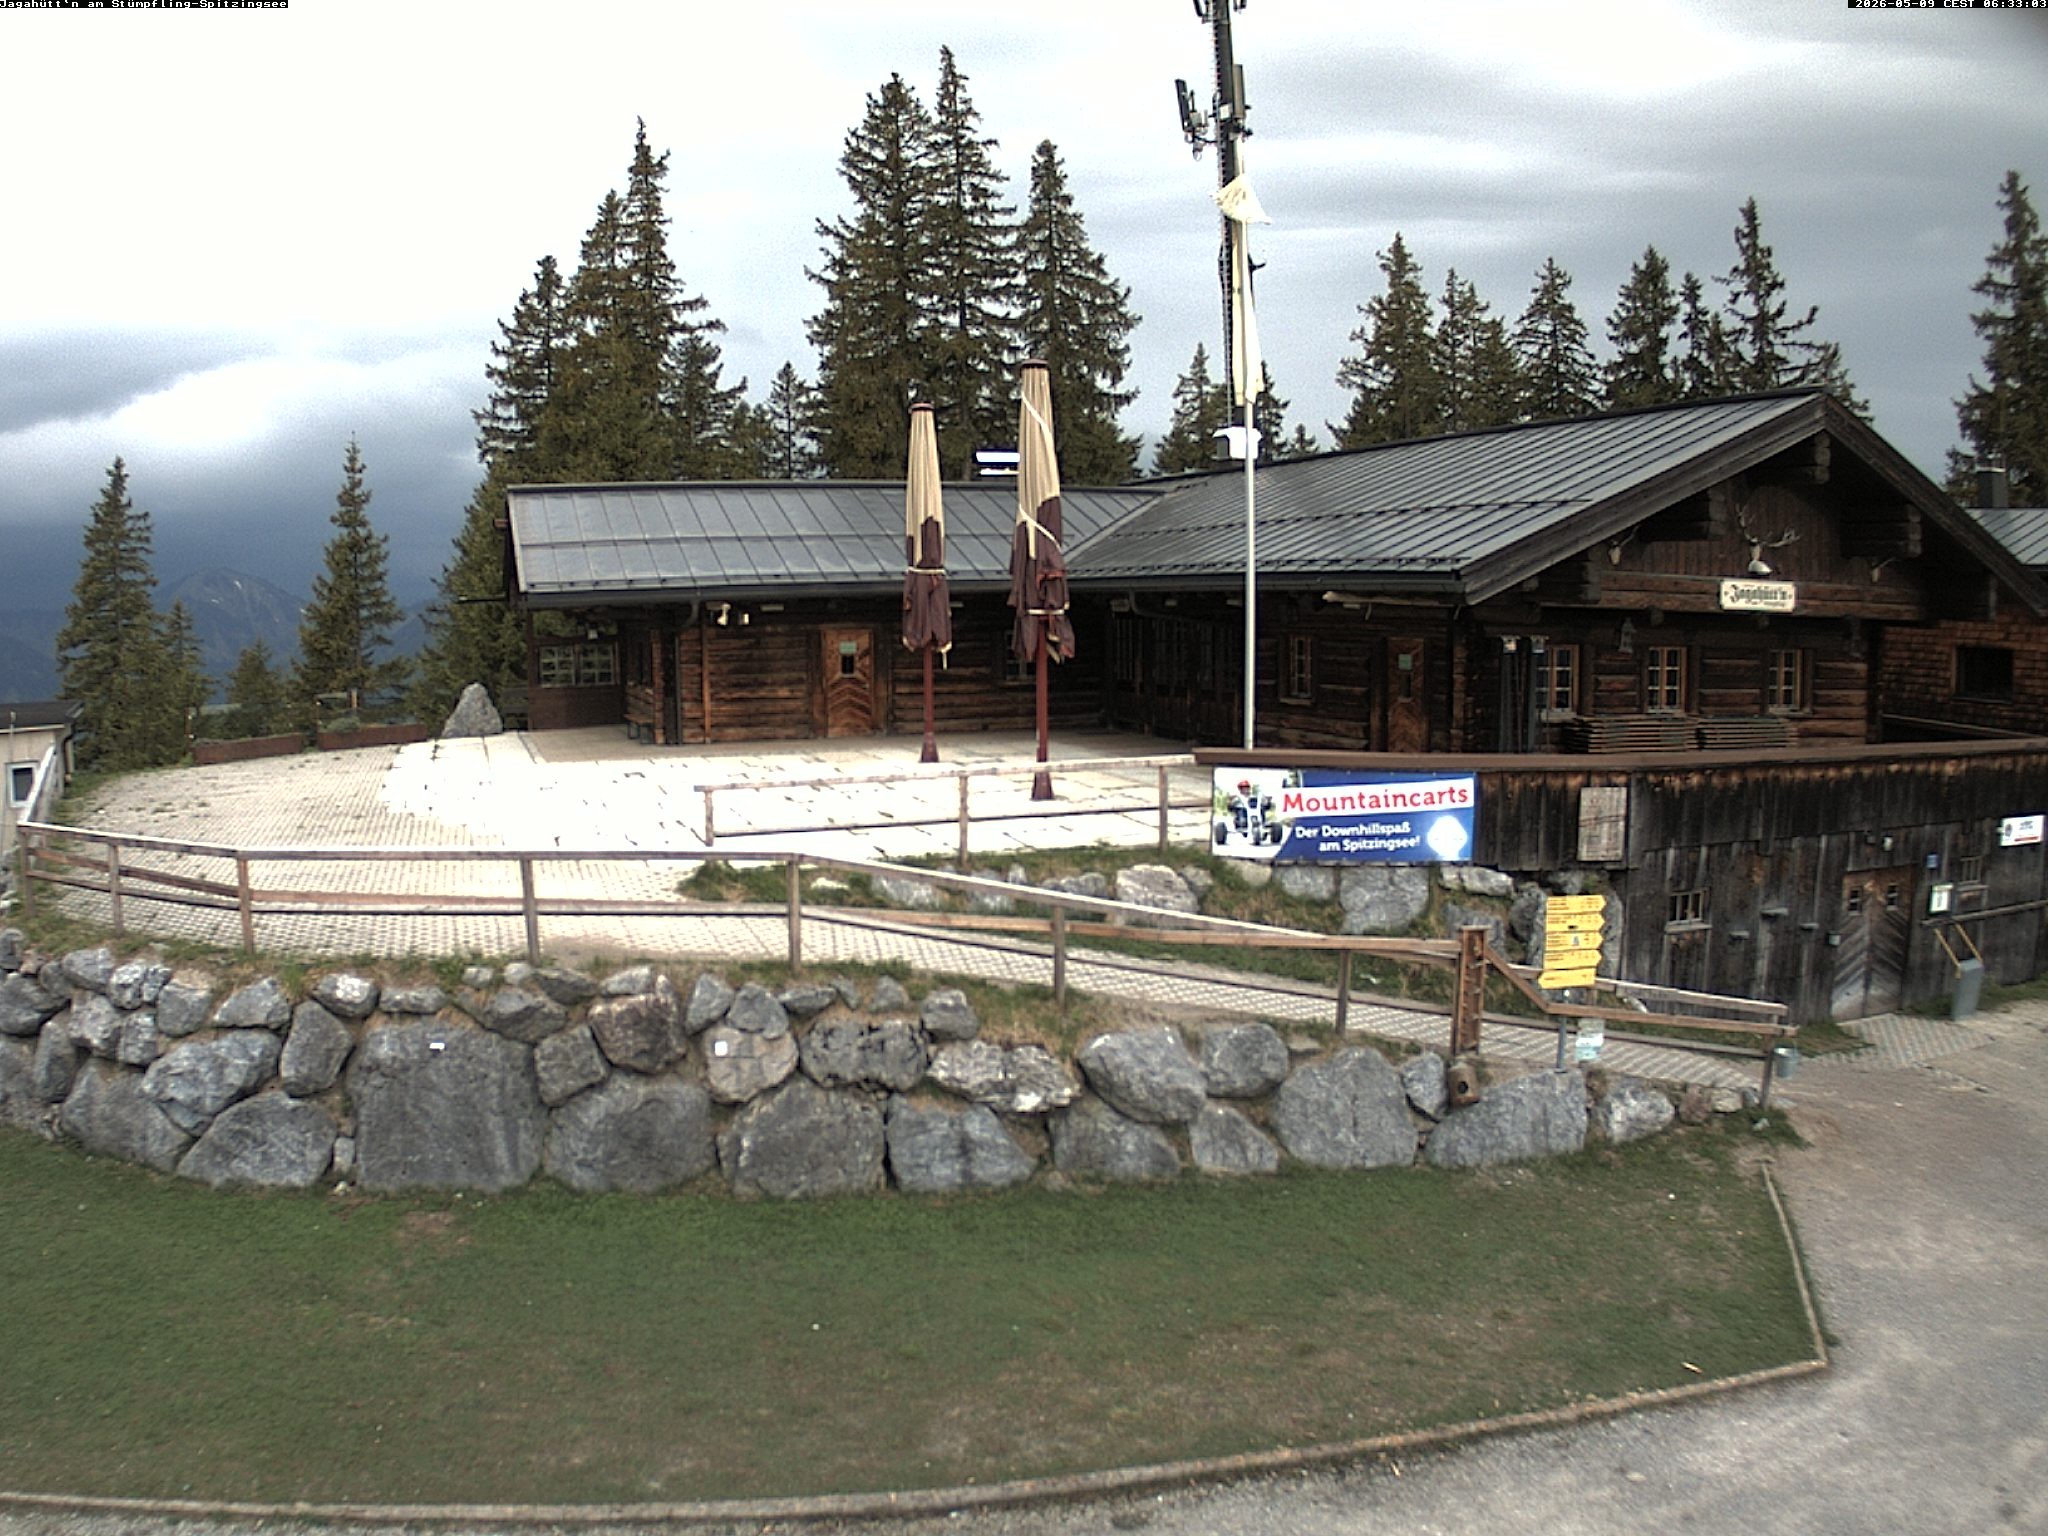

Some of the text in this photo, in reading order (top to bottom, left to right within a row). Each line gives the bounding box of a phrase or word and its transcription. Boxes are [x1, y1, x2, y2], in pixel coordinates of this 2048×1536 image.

[1283, 786, 1468, 812] Mountaincarts
[1295, 821, 1411, 838] Der Downhillspaß
[1319, 841, 1340, 851] am
